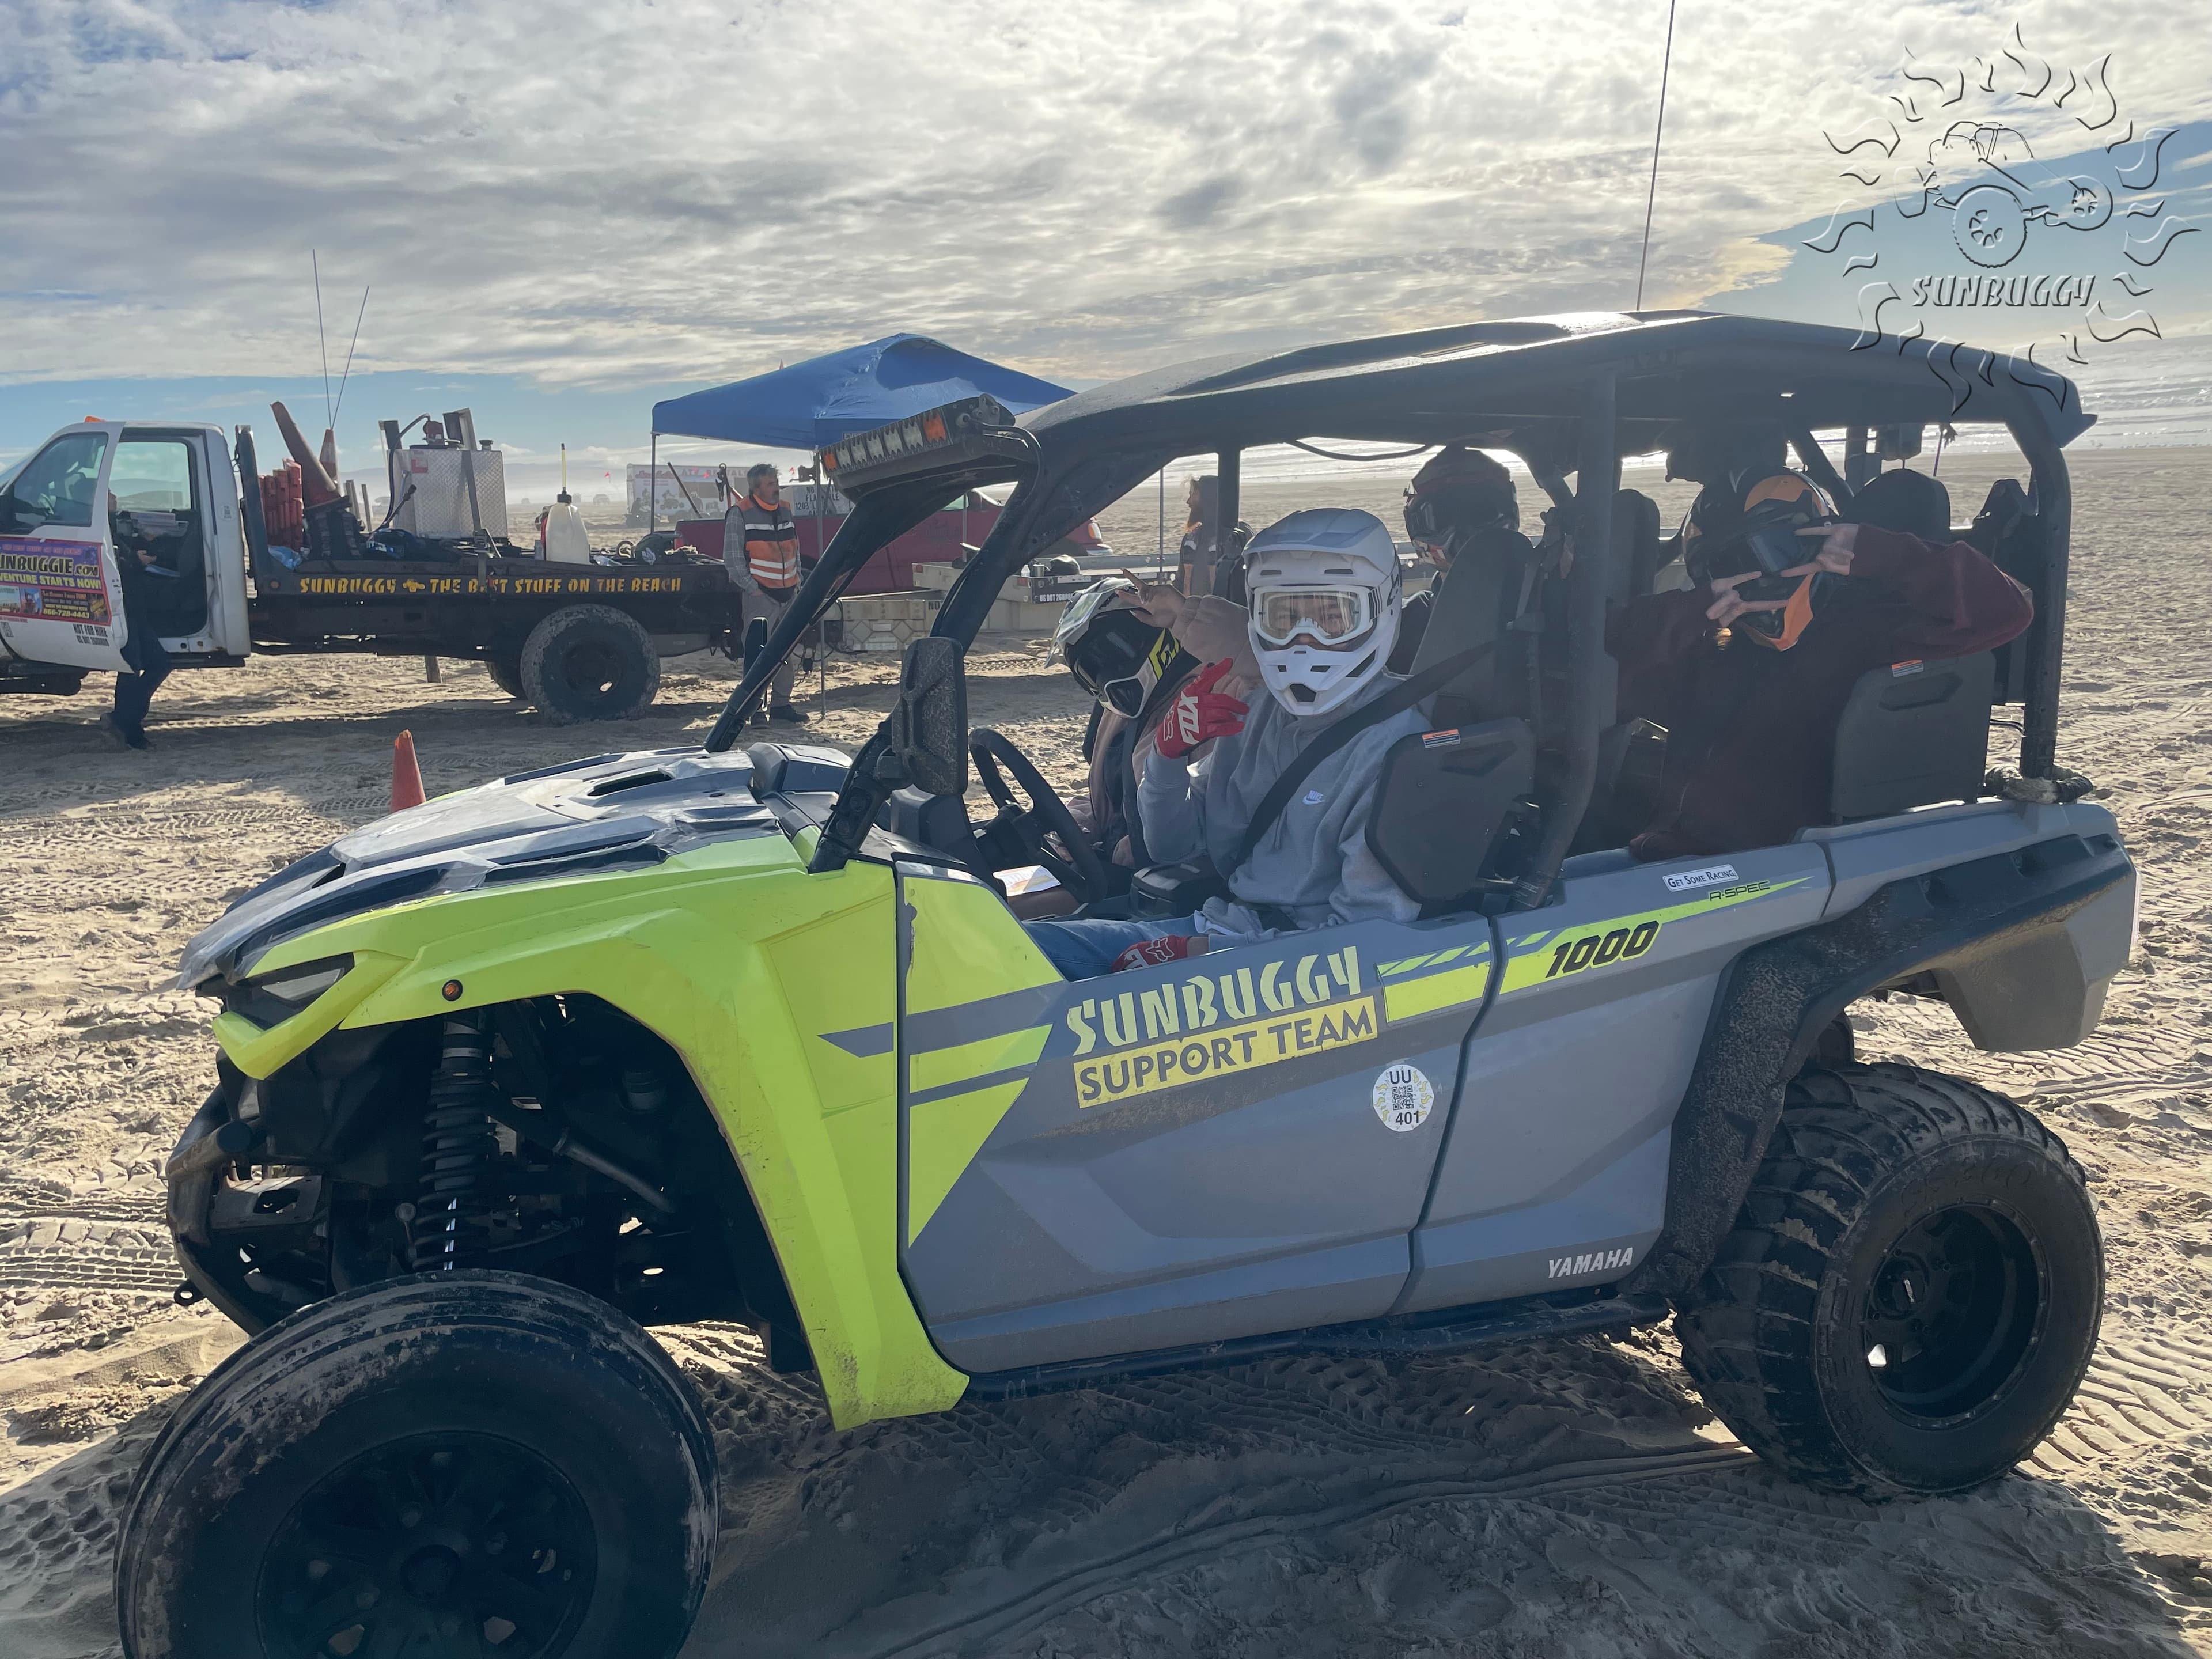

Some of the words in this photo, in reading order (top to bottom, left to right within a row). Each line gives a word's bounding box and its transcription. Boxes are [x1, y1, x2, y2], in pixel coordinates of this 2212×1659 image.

[40, 575, 74, 587] STARTS
[77, 578, 101, 589] NOW!
[300, 577, 396, 593] SUNBUGGY
[430, 578, 461, 593] THE
[515, 578, 561, 593] STUFF
[568, 578, 590, 593] ON
[597, 578, 625, 593] THE
[631, 577, 681, 592] BEACH
[1177, 691, 1199, 745] FOX
[1544, 920, 1660, 978] 1000
[1066, 946, 1362, 1056] SUNBUGGY
[1079, 1036, 1256, 1102] SUPPORT
[1272, 1005, 1374, 1055] TEAM
[1389, 1069, 1412, 1084] UU
[1395, 1110, 1419, 1125] 401
[1548, 1247, 1633, 1279] YAMAHA
